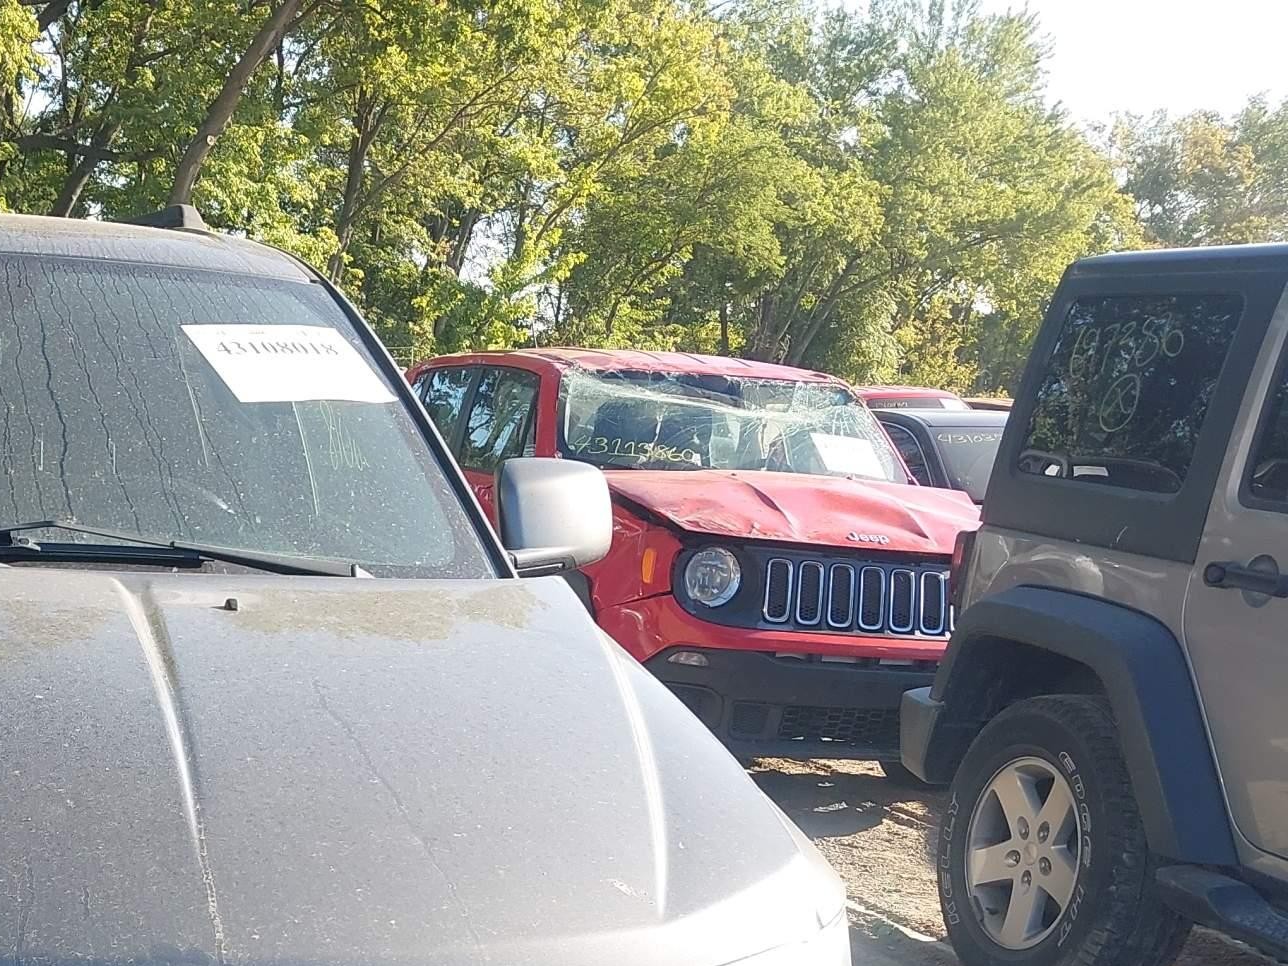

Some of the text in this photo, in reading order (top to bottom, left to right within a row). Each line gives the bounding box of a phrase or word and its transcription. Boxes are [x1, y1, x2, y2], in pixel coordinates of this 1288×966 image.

[216, 340, 339, 356] 43108018
[846, 531, 889, 545] Jeep
[1058, 751, 1091, 868] EDGE
[941, 791, 960, 924] KELLY
